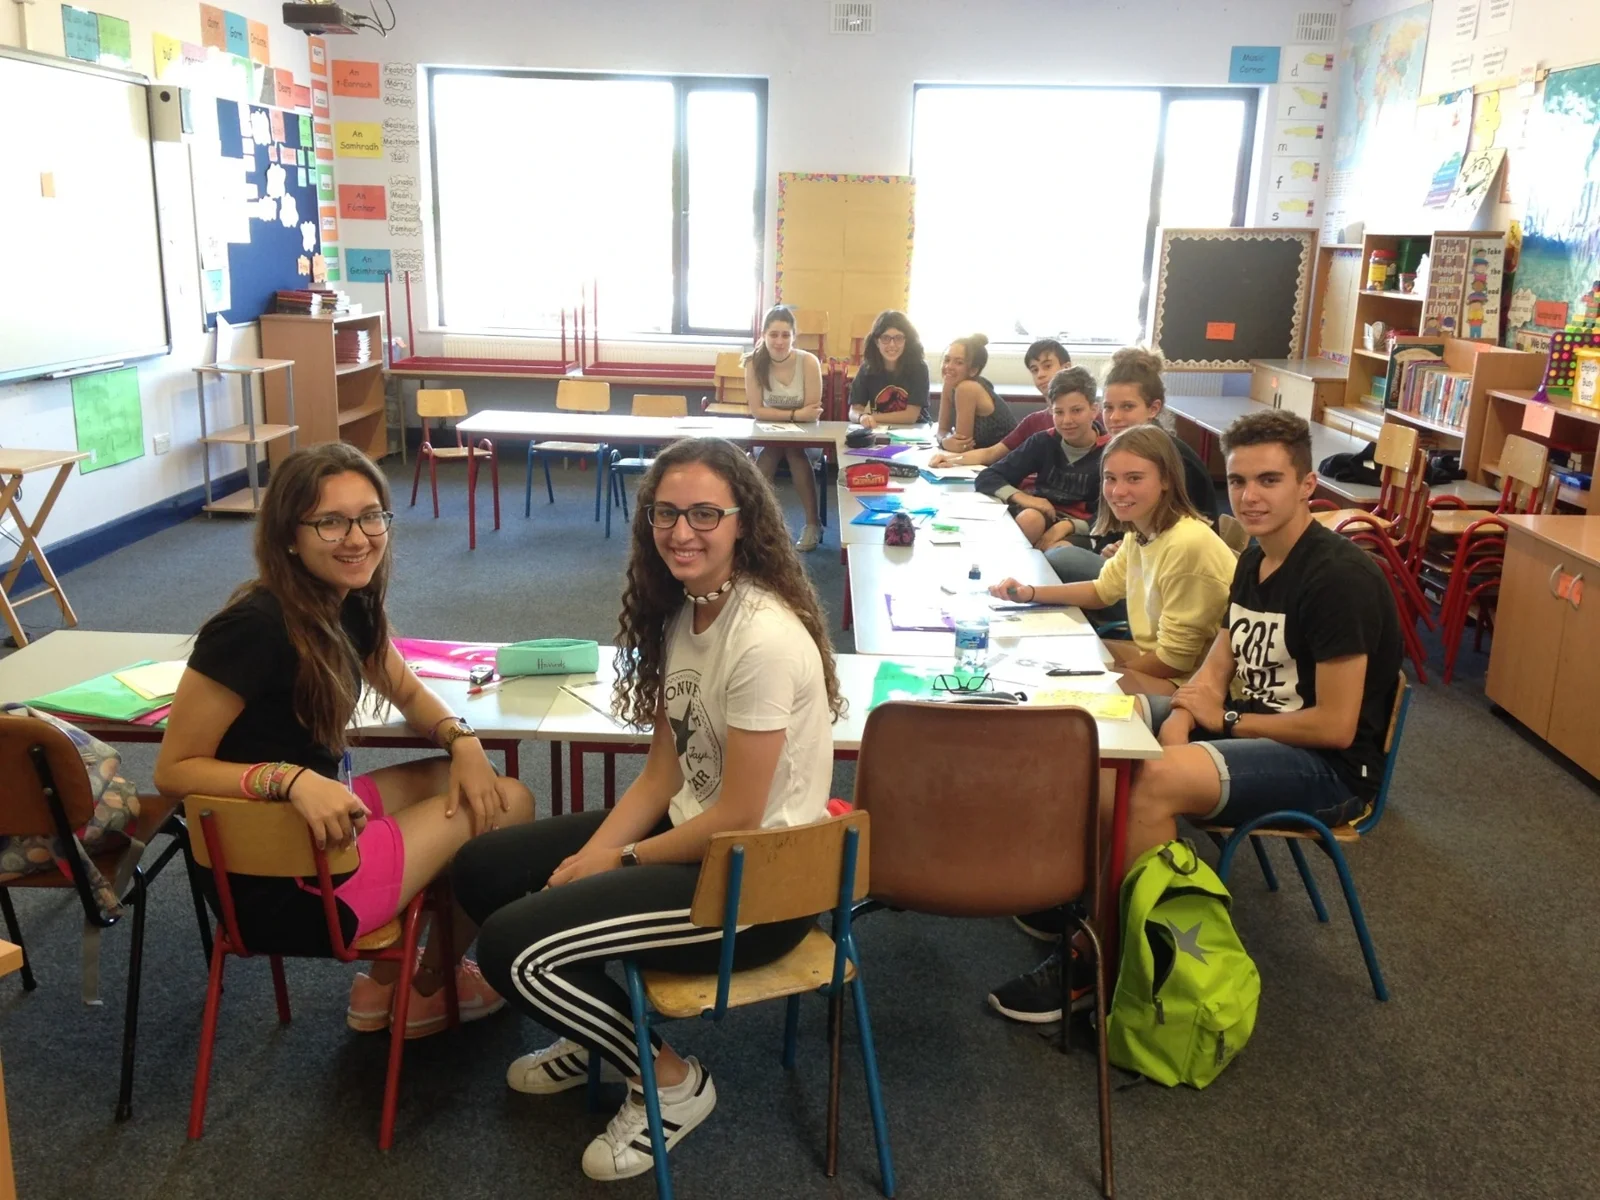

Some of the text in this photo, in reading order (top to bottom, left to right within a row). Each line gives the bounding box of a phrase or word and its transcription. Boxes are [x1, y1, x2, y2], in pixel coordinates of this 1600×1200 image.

[1242, 54, 1265, 62] Music
[1240, 65, 1266, 73] Corner
[1291, 63, 1299, 77] d
[1287, 105, 1296, 116] r
[352, 130, 363, 138] An
[340, 142, 379, 151] Samhradh
[1277, 143, 1288, 152] m
[1276, 175, 1283, 189] f
